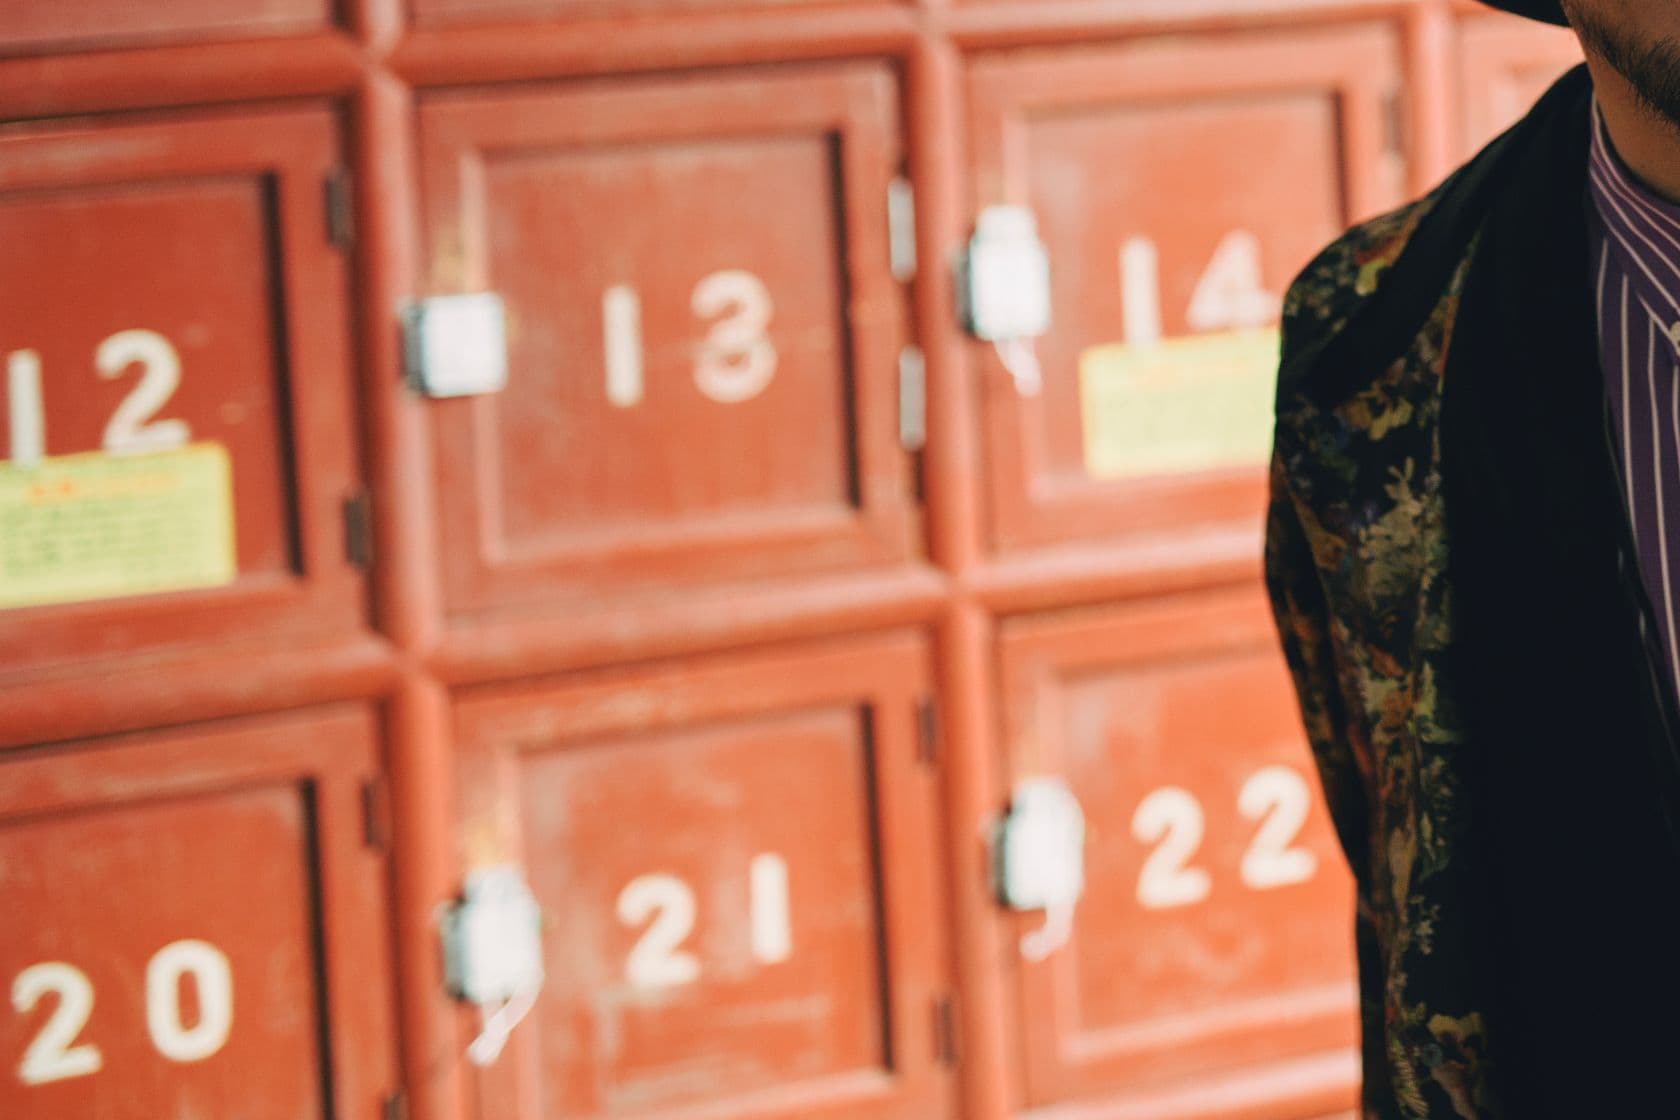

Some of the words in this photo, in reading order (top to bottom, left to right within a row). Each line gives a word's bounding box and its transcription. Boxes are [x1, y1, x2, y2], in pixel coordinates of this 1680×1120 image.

[604, 270, 778, 407] 13
[1118, 230, 1282, 348] 14
[6, 329, 190, 466] 12
[1133, 767, 1316, 907] 22
[618, 852, 790, 986] 21
[12, 939, 232, 1083] 20
